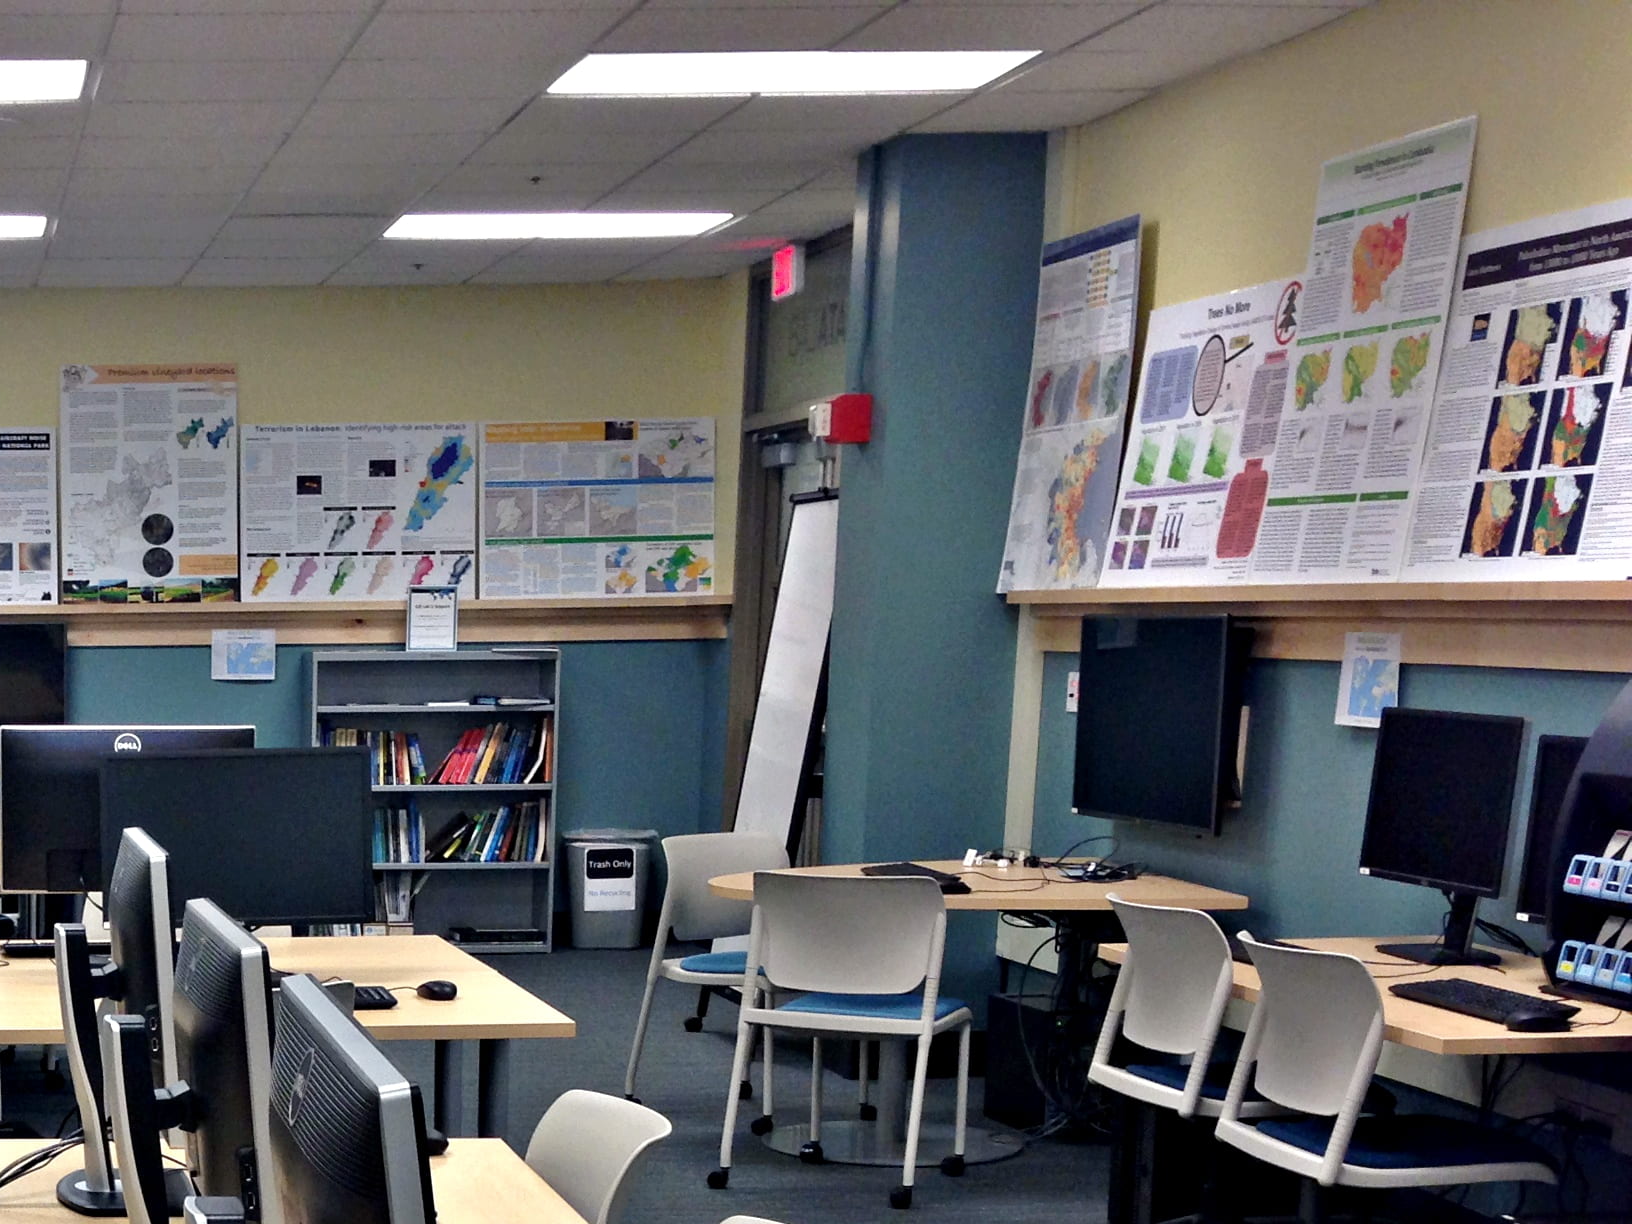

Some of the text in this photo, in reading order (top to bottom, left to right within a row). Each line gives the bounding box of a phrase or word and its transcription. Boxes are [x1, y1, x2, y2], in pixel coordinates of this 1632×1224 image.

[1225, 304, 1234, 316] No
[255, 425, 294, 433] Terrorism
[295, 425, 304, 433] in
[117, 742, 138, 750] DELL
[589, 859, 632, 869] Trash Only
